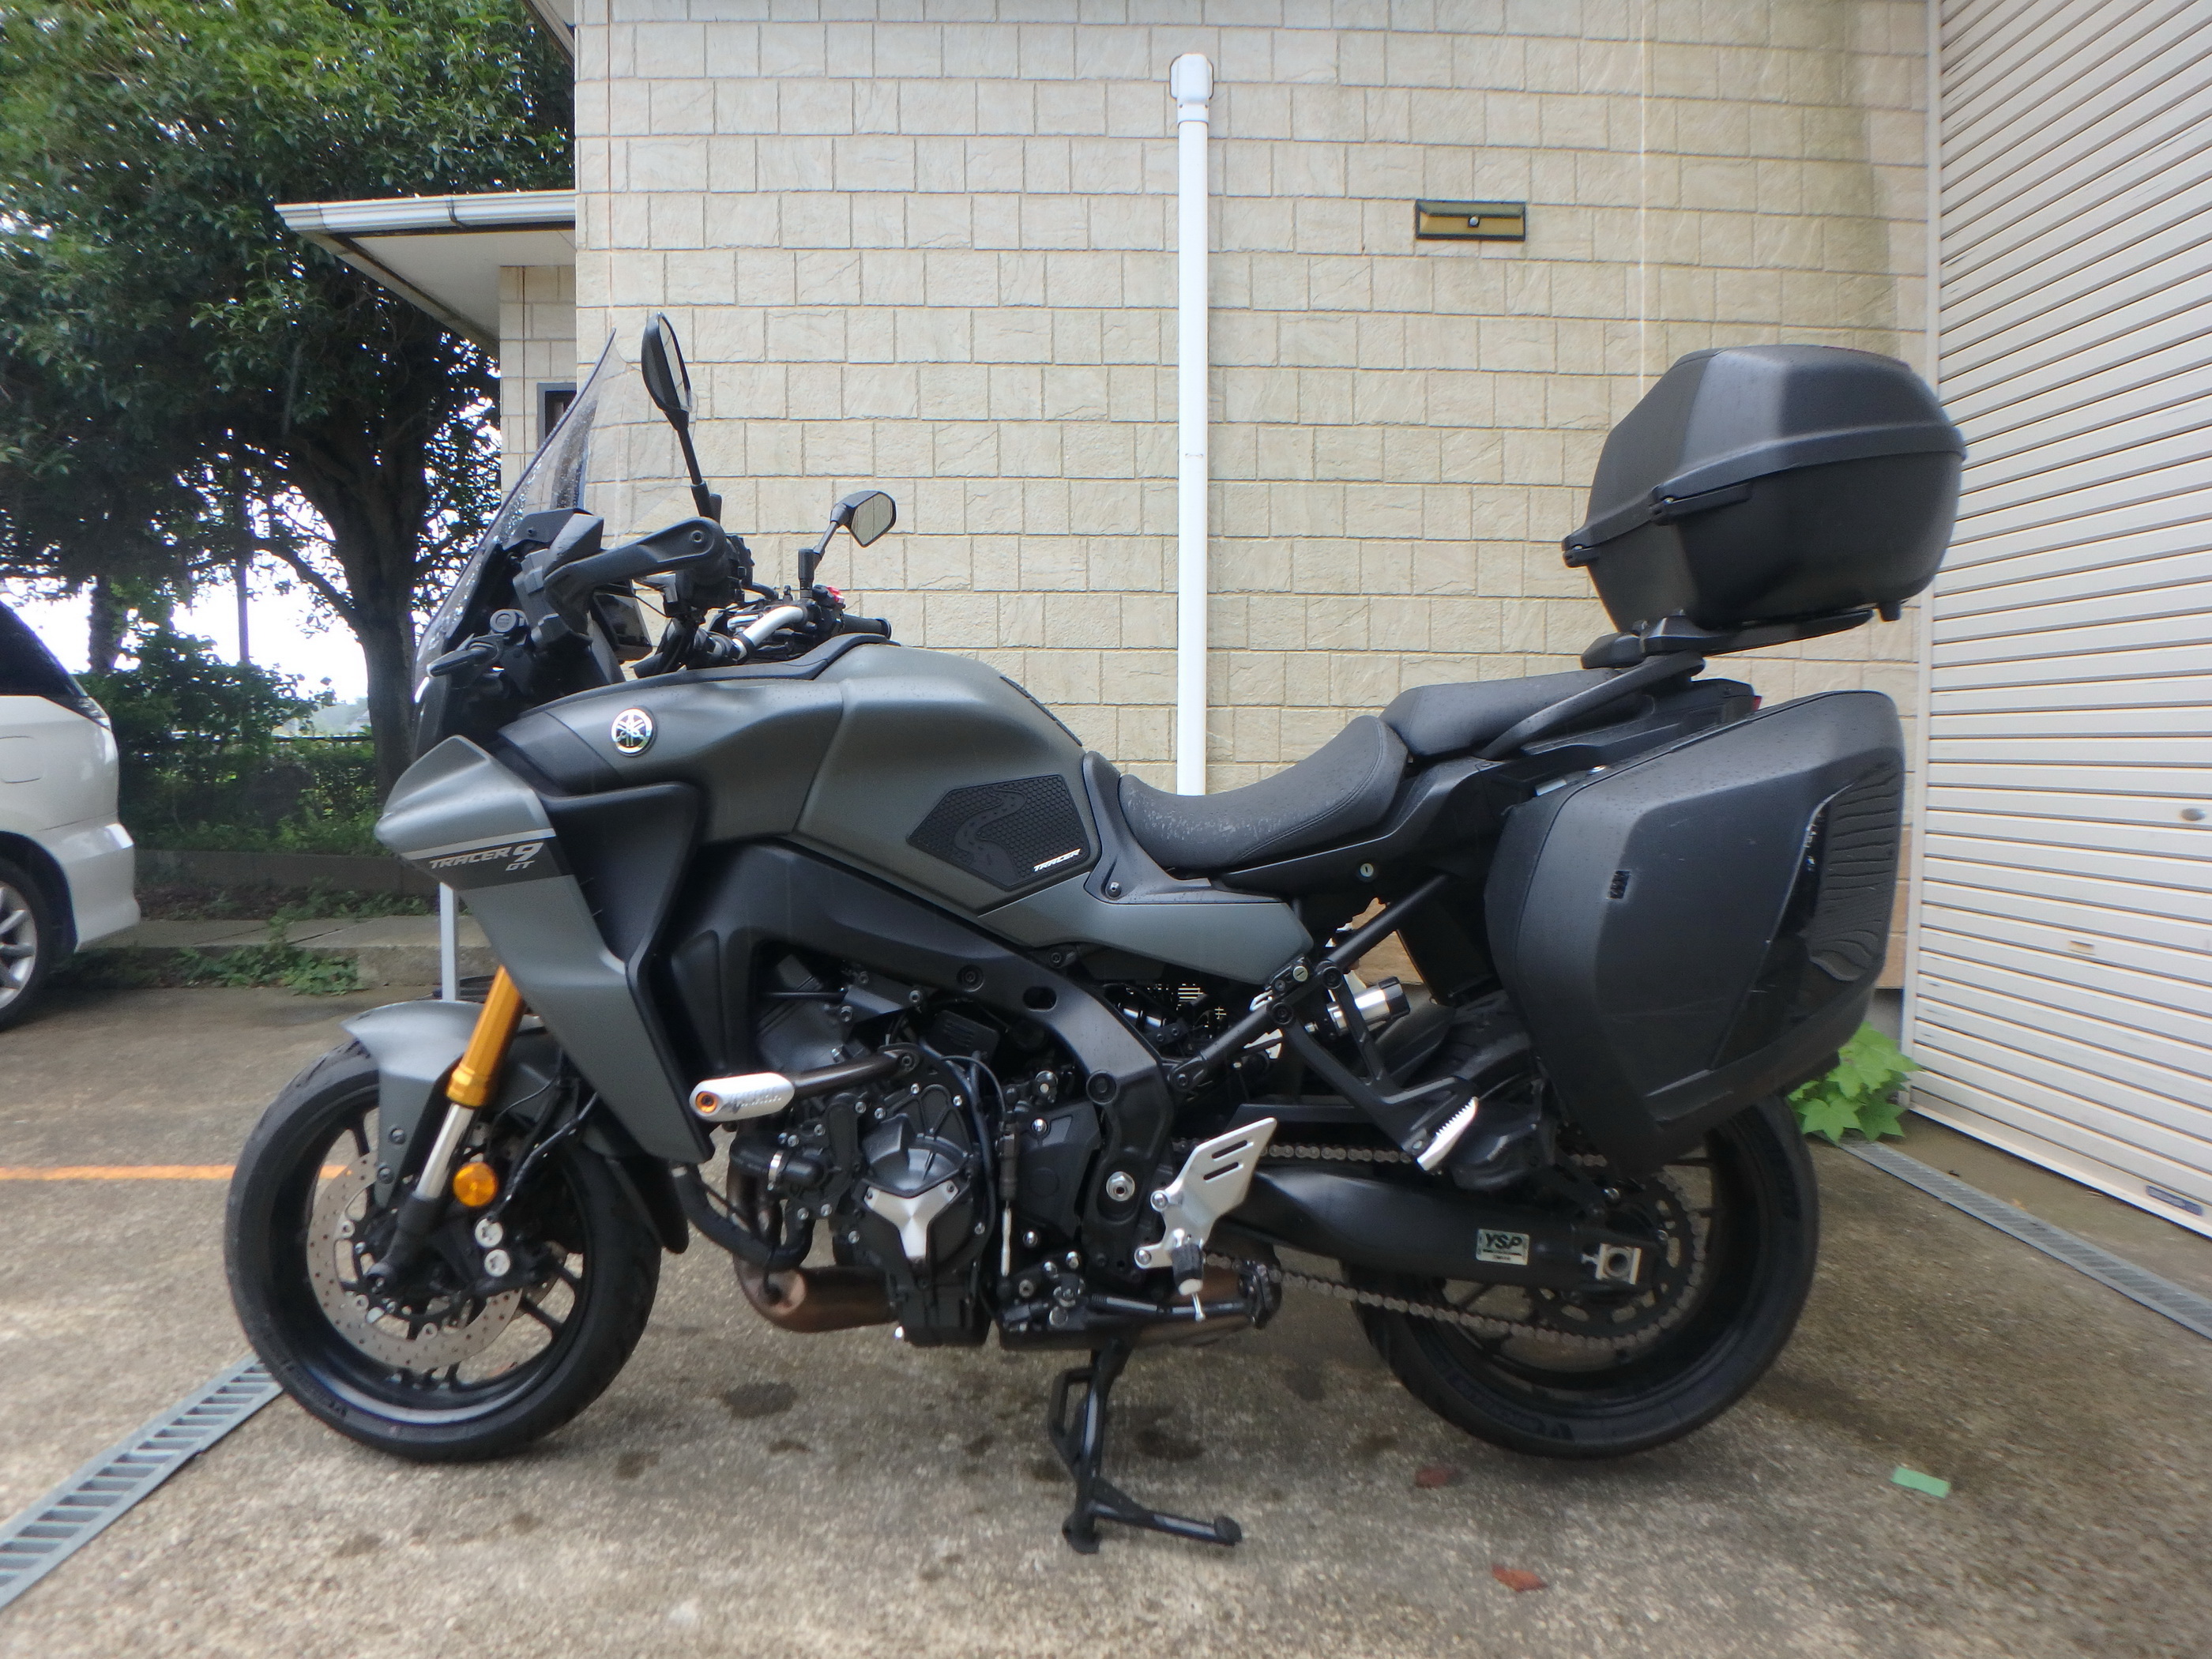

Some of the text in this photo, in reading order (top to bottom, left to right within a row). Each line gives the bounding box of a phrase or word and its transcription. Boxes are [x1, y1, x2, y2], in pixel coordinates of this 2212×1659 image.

[429, 841, 544, 870] TRACER 9
[505, 860, 536, 871] GT
[1485, 1233, 1523, 1250] YSP
